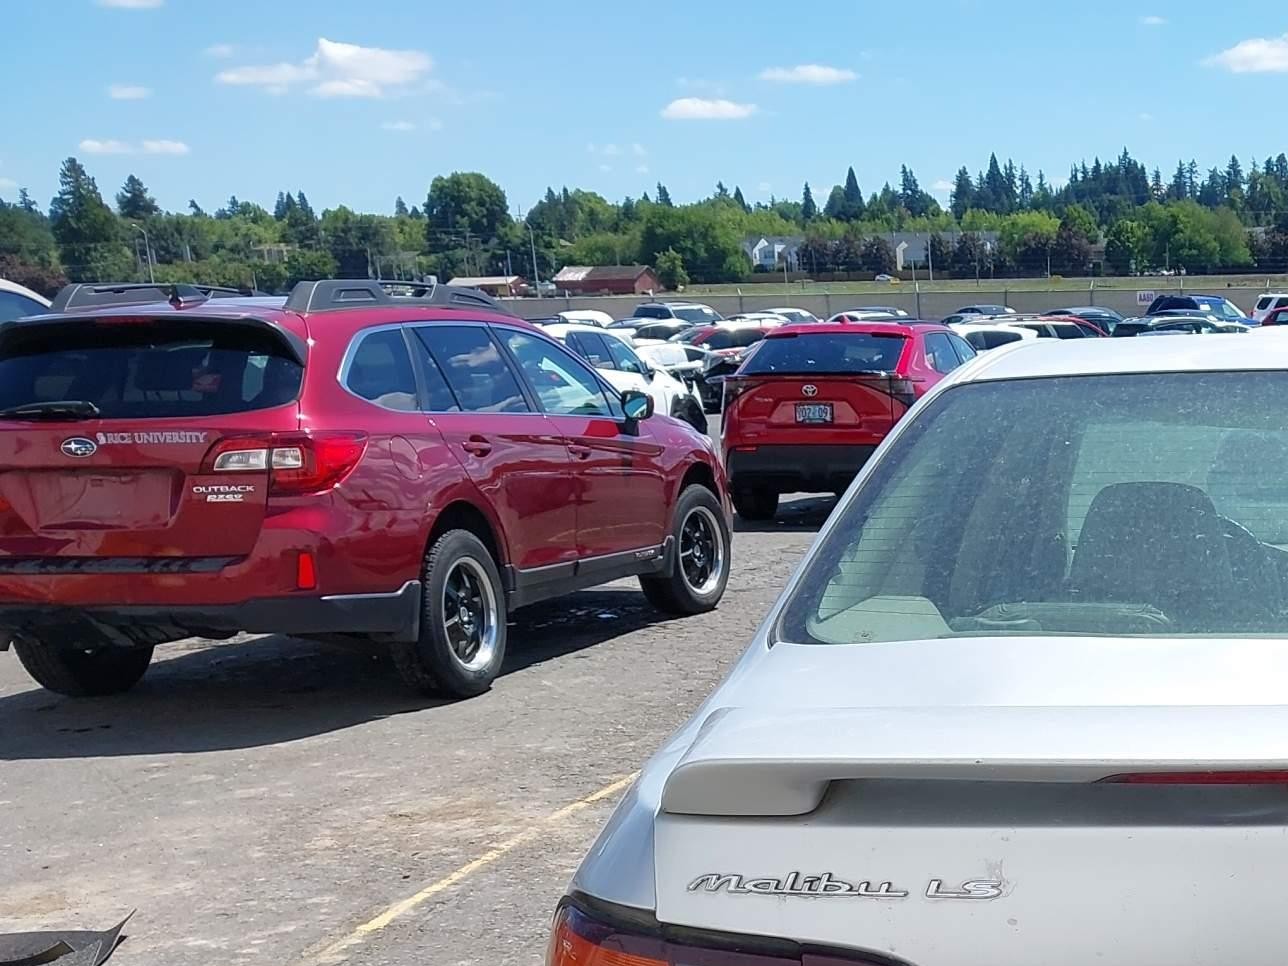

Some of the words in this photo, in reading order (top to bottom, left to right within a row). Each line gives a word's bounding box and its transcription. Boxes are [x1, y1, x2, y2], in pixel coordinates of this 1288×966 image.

[106, 432, 132, 444] RICE
[134, 431, 208, 444] UNIVERSITY
[192, 485, 256, 493] OUTBACK
[687, 871, 909, 897] Malibu
[925, 879, 1003, 899] LS
